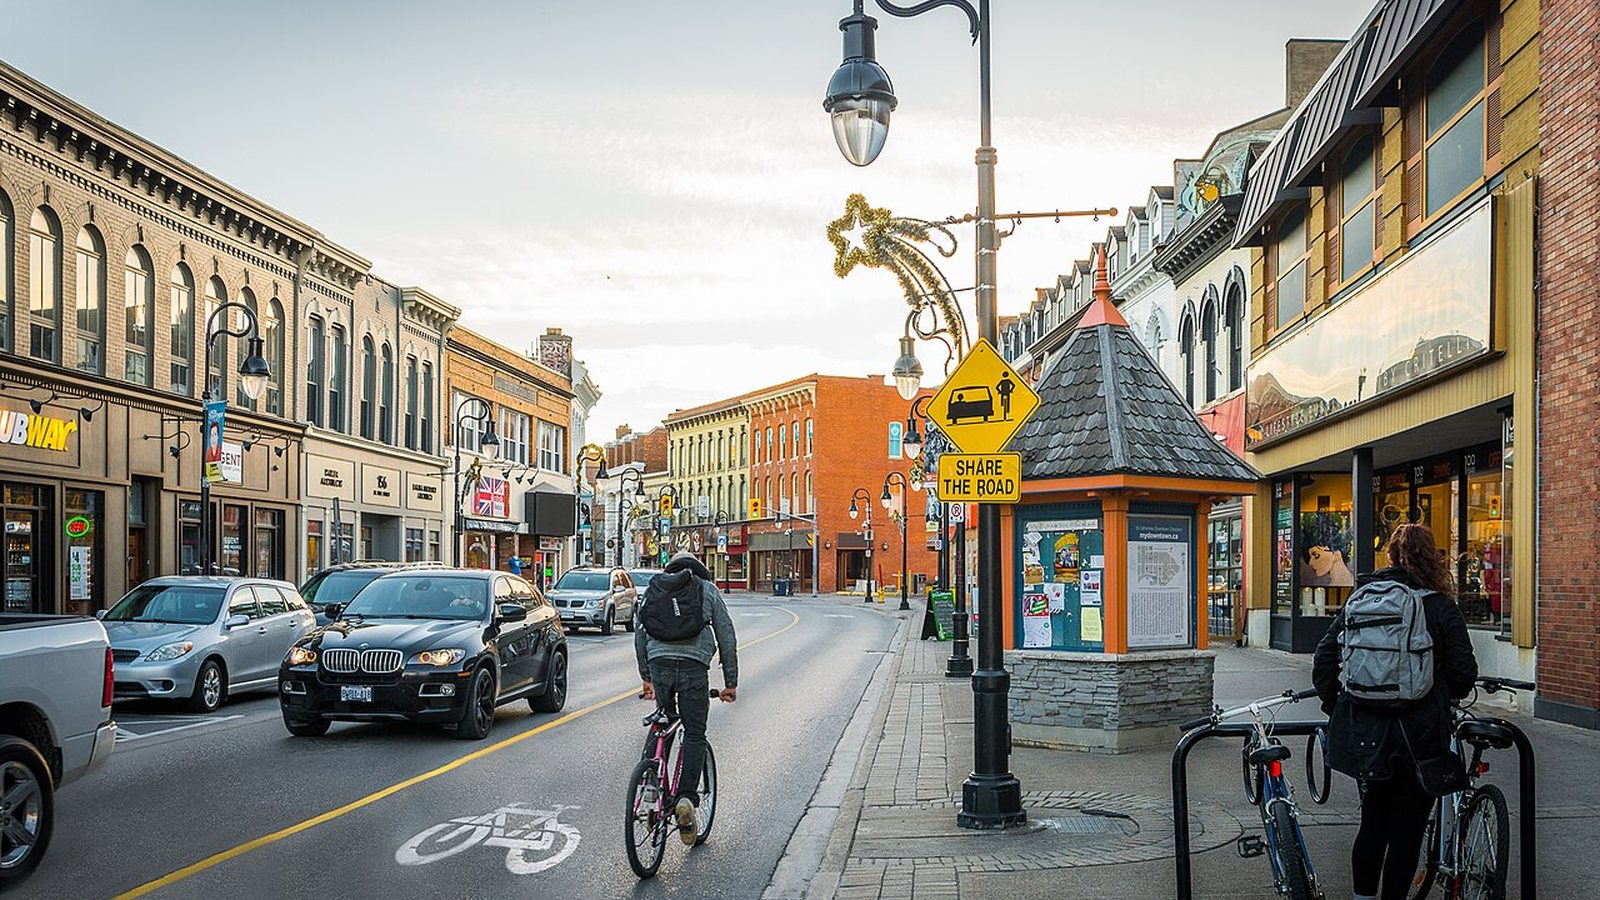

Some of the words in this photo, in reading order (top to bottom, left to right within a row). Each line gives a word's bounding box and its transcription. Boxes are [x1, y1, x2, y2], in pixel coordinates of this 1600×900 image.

[1383, 368, 1396, 387] BY
[0, 409, 78, 453] UBWAY
[956, 459, 1003, 476] SHARE
[943, 479, 971, 495] THE
[976, 478, 1015, 495] ROAD
[1139, 532, 1179, 540] mydowntown.ca
